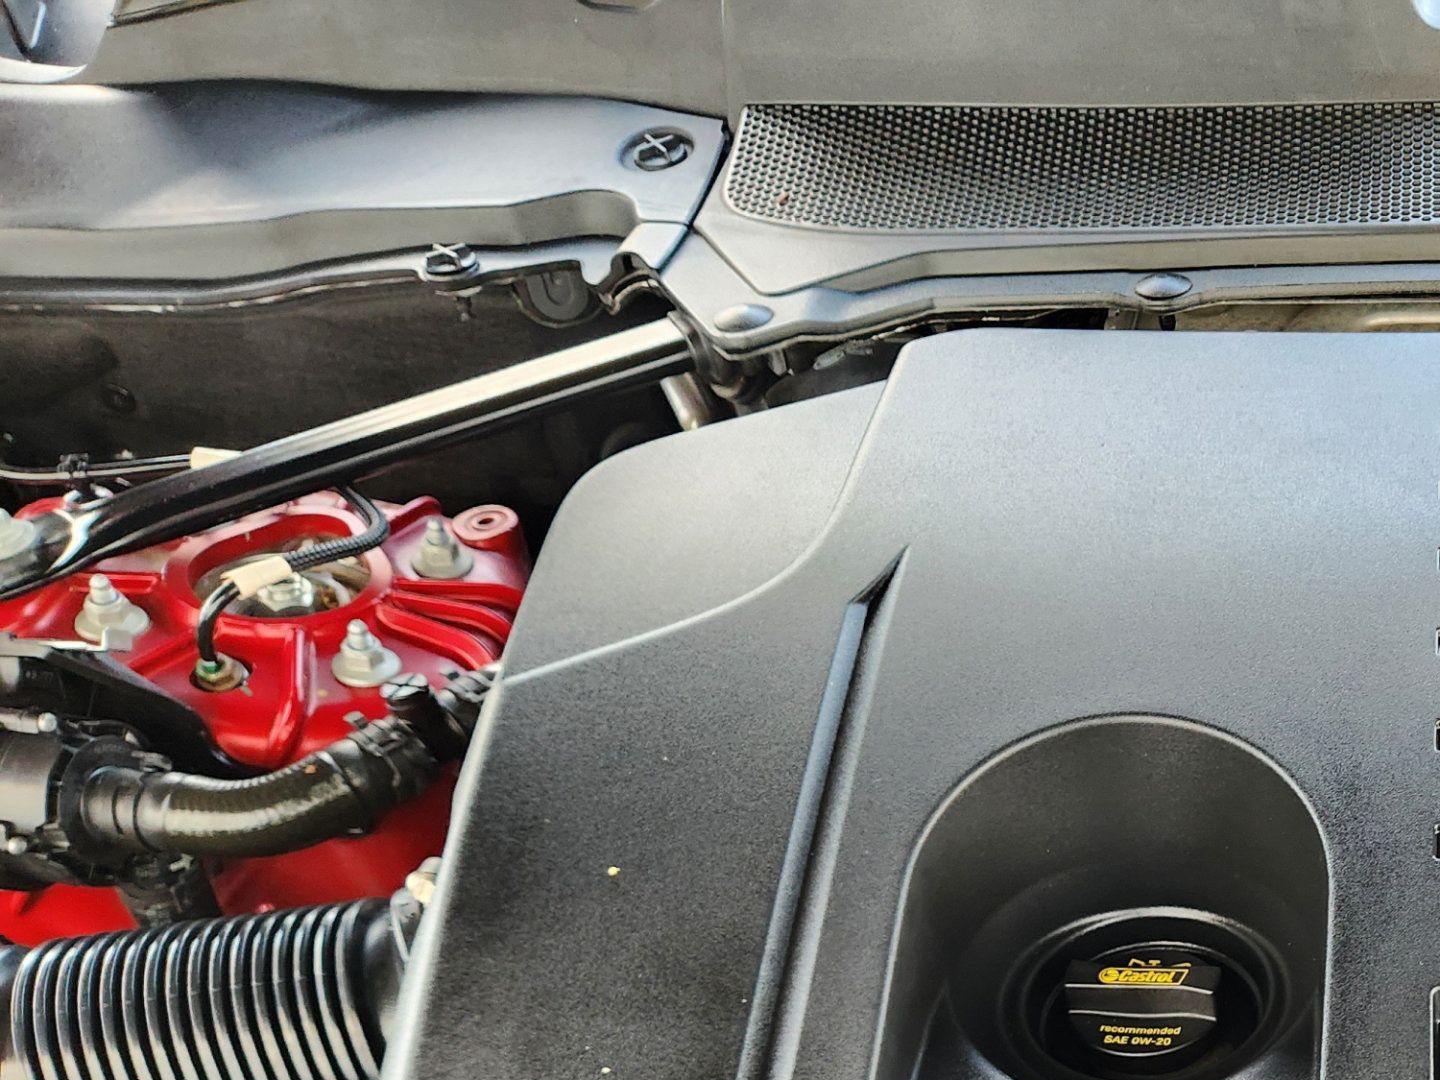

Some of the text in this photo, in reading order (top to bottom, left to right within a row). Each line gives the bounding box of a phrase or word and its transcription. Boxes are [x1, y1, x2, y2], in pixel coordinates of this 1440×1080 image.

[1118, 969, 1176, 983] Castrol
[1100, 1025, 1182, 1035] recommended
[1104, 1035, 1171, 1046] SAE 0W-20
